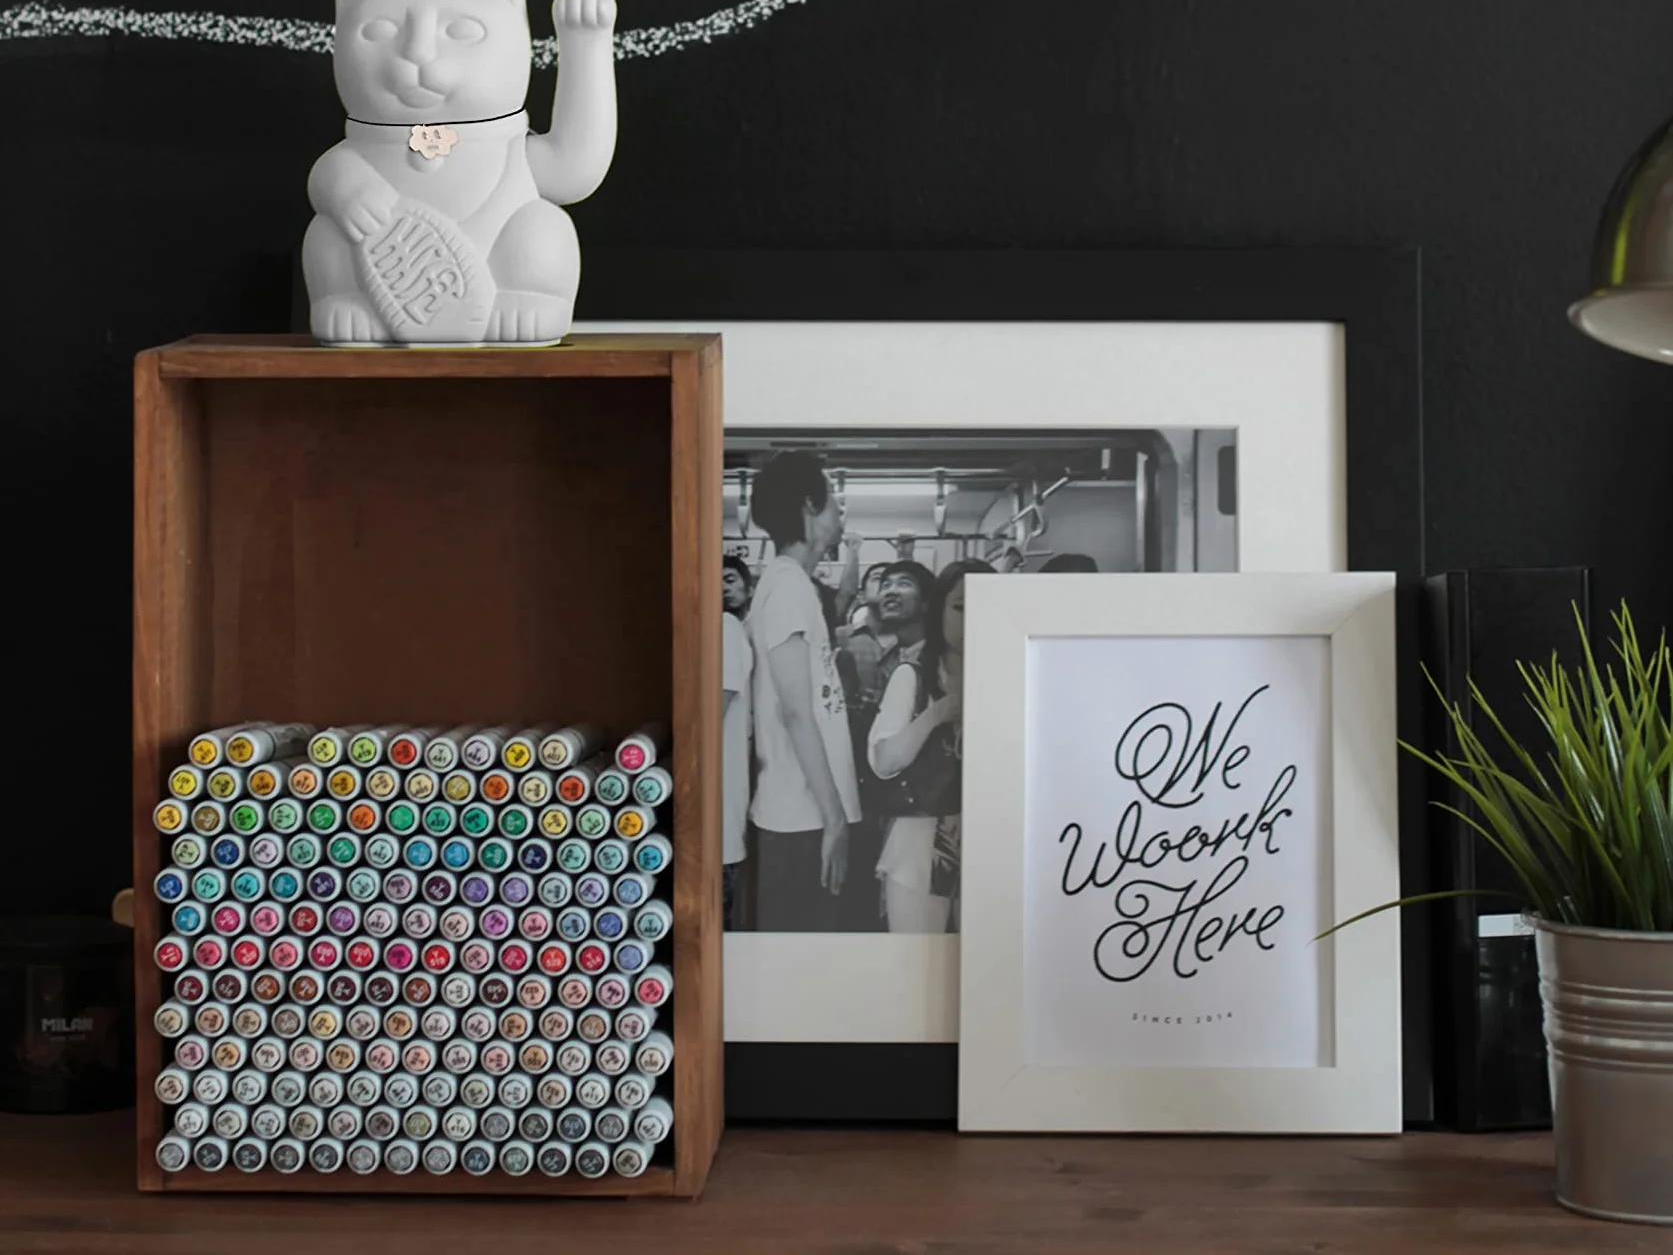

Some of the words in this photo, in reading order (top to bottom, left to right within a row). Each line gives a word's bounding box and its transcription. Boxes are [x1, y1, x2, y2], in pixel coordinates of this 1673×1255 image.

[1114, 684, 1271, 809] We
[1058, 764, 1298, 896] Woork
[1093, 855, 1285, 983] Here
[41, 1017, 94, 1032] MILAN
[1131, 1012, 1183, 1025] SINCE
